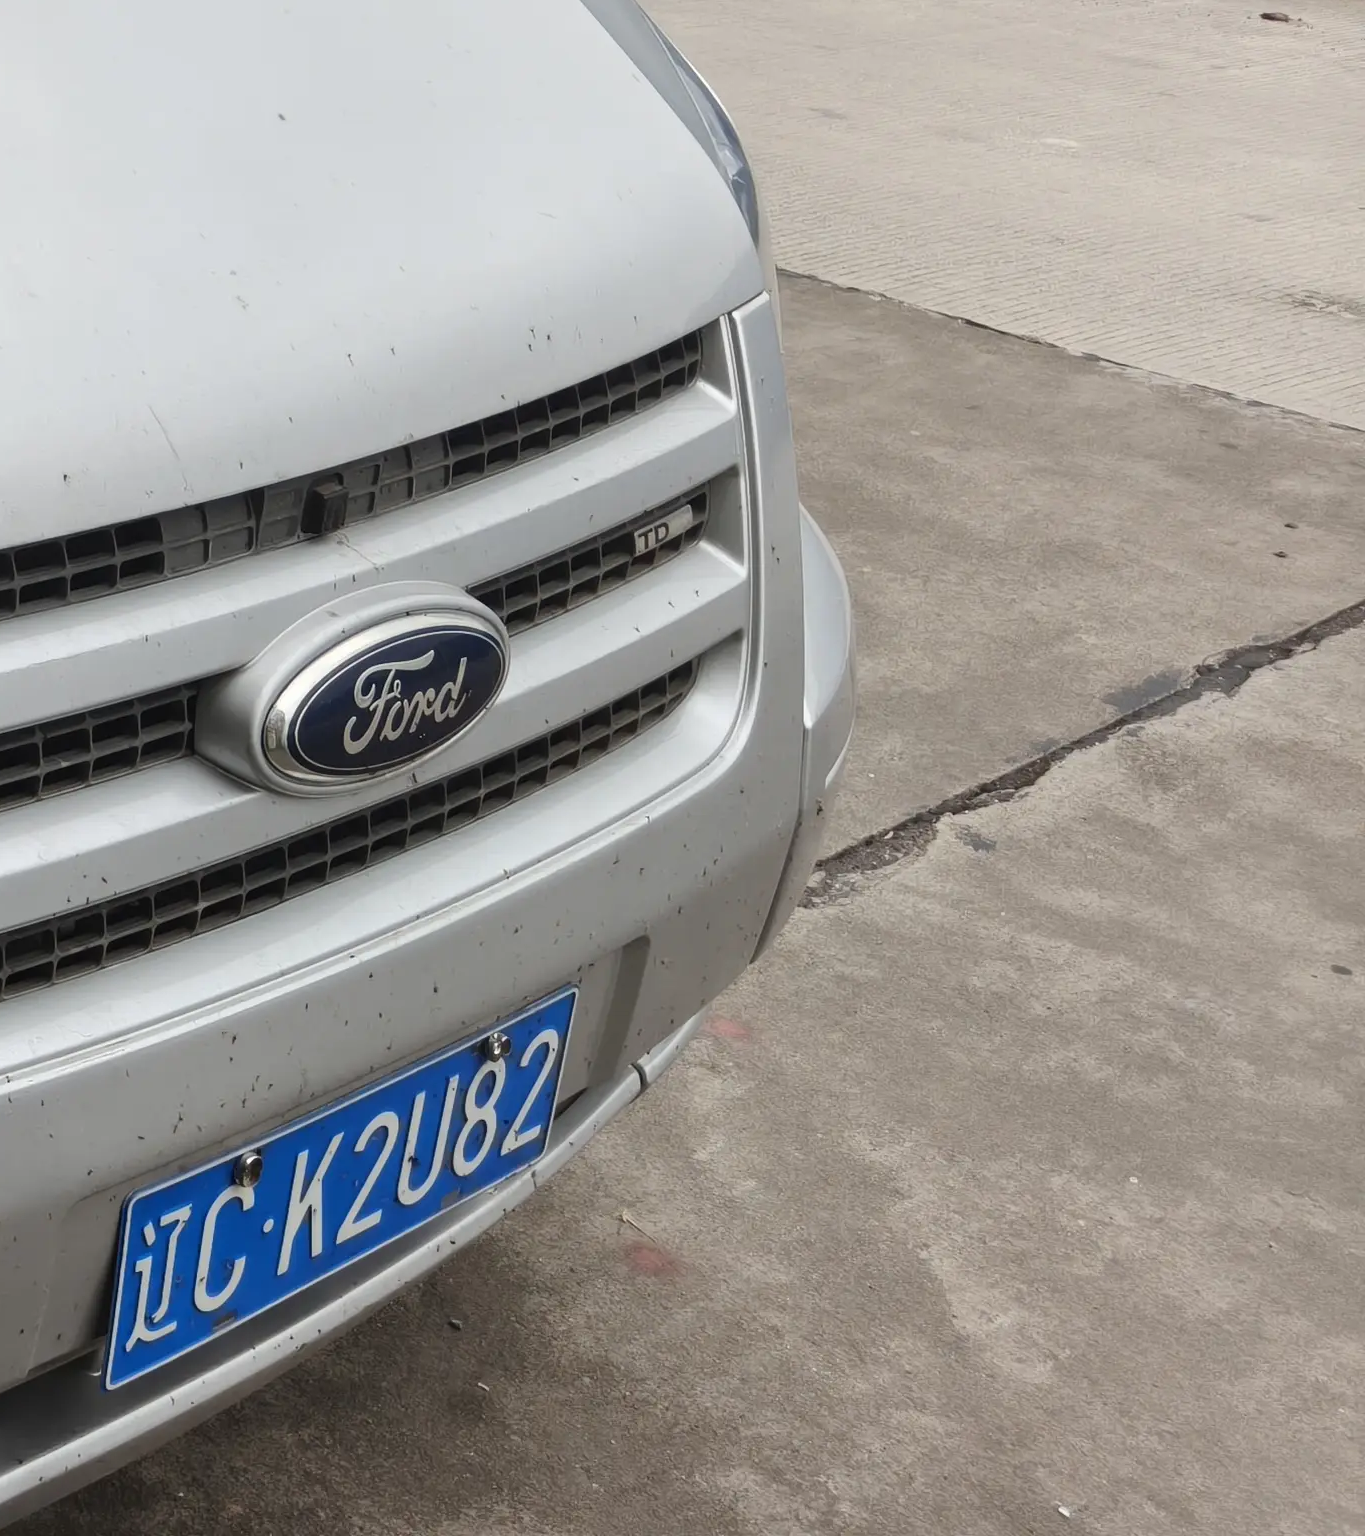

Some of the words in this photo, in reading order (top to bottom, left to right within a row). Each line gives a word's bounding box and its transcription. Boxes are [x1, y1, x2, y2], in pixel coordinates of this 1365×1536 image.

[637, 521, 670, 551] TD
[342, 648, 468, 756] Ford
[125, 1027, 560, 1353] 辽C·K2U82
